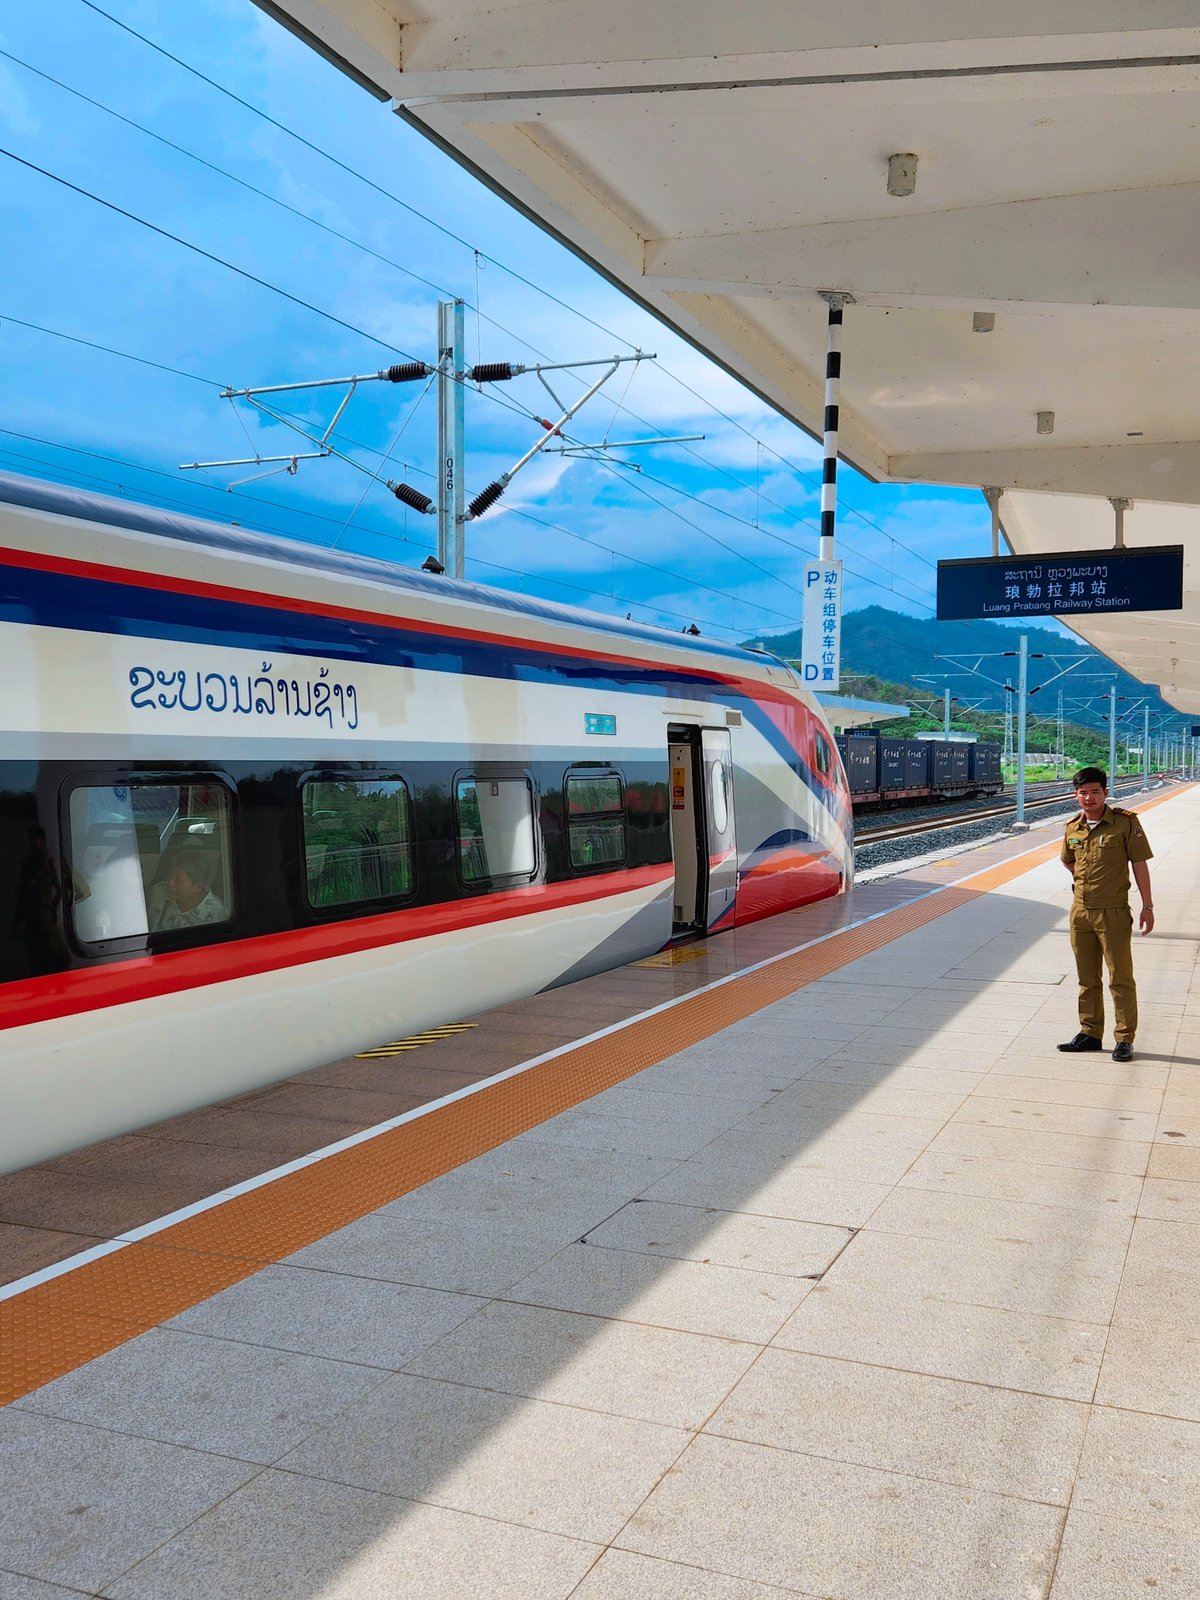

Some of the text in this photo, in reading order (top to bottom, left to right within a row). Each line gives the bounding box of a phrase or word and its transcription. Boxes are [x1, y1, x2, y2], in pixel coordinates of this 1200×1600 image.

[446, 457, 454, 490] 046
[808, 571, 820, 588] P
[1005, 580, 1107, 599] 琅勃拉邦站
[983, 597, 1130, 613] Luang Prabang Railway Station
[822, 571, 837, 681] 动车组停车位置
[805, 664, 818, 681] D
[130, 661, 358, 729] ຂະບວນລ້ານຊ້າງ
